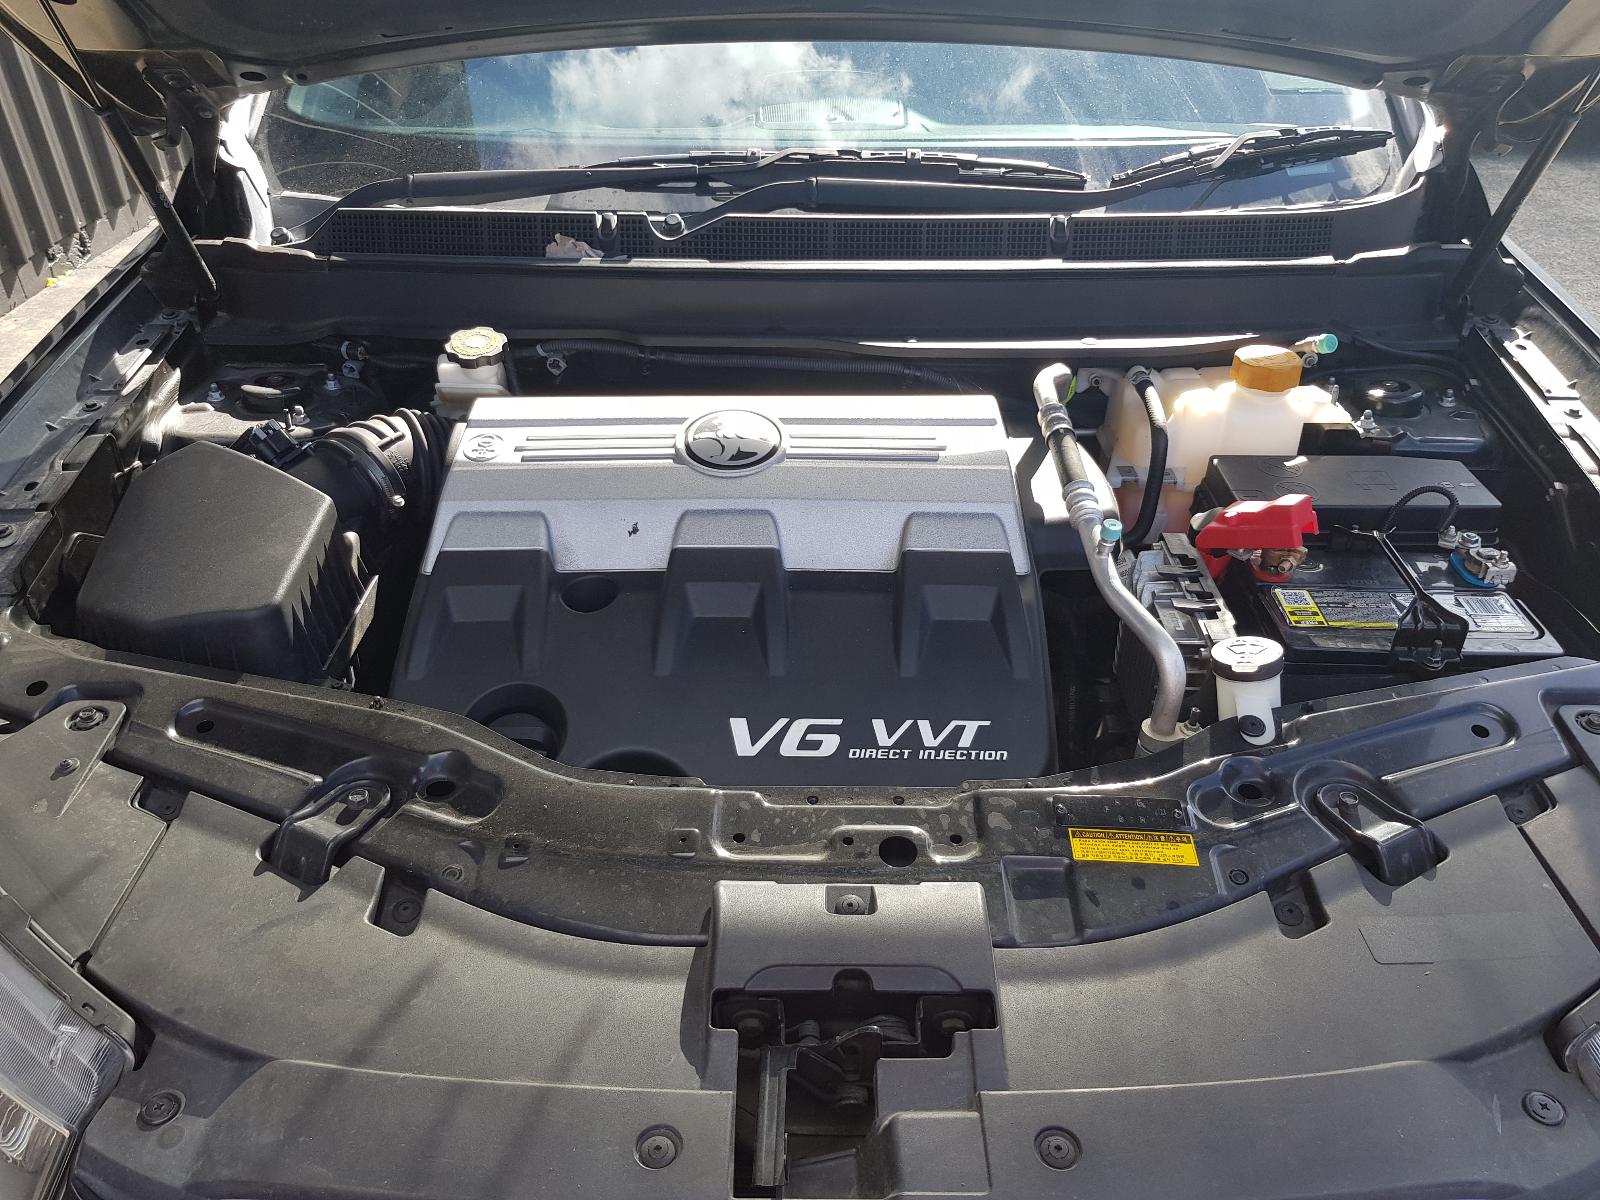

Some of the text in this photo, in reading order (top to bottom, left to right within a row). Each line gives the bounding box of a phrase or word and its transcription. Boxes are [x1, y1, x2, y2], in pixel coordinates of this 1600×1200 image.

[729, 717, 992, 757] V6 VVT
[848, 748, 1008, 761] DIRECT INJECTION
[1082, 831, 1105, 839] CAUTION
